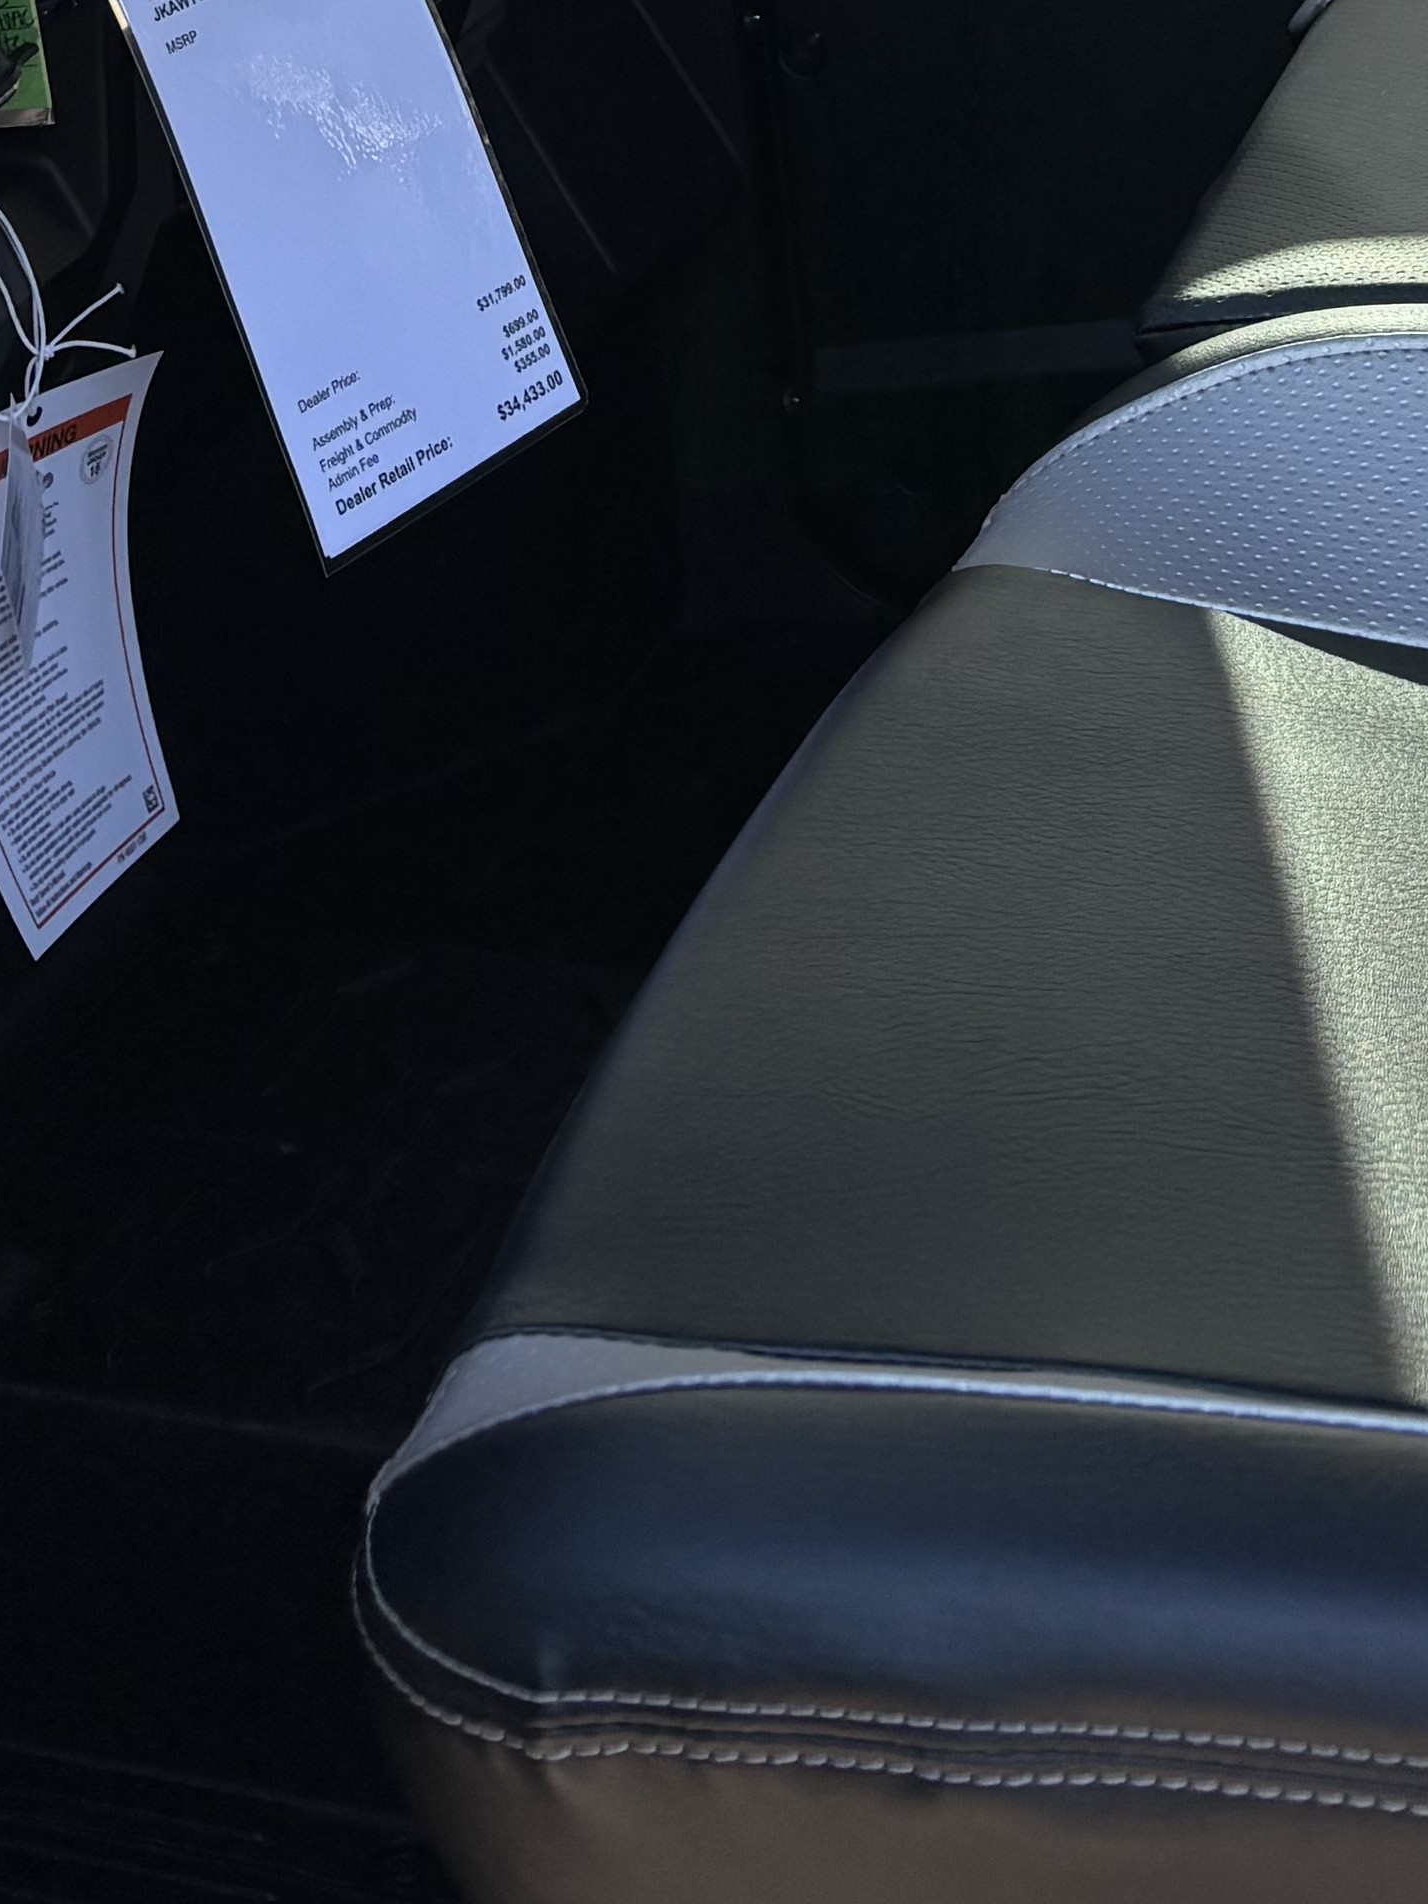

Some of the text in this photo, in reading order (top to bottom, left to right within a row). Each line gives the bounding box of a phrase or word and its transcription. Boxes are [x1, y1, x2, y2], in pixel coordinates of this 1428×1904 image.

[165, 30, 198, 55] MSRP
[297, 386, 330, 414] Dealer
[330, 370, 361, 396] Price:
[313, 416, 359, 451] Assembly
[368, 394, 396, 418] Prep:
[319, 445, 356, 473] Freight
[364, 407, 417, 446] Commodity
[335, 370, 563, 516] Dealer Retail Price: $34,433.00
[327, 465, 360, 492] Admin
[359, 452, 380, 472] Fee
